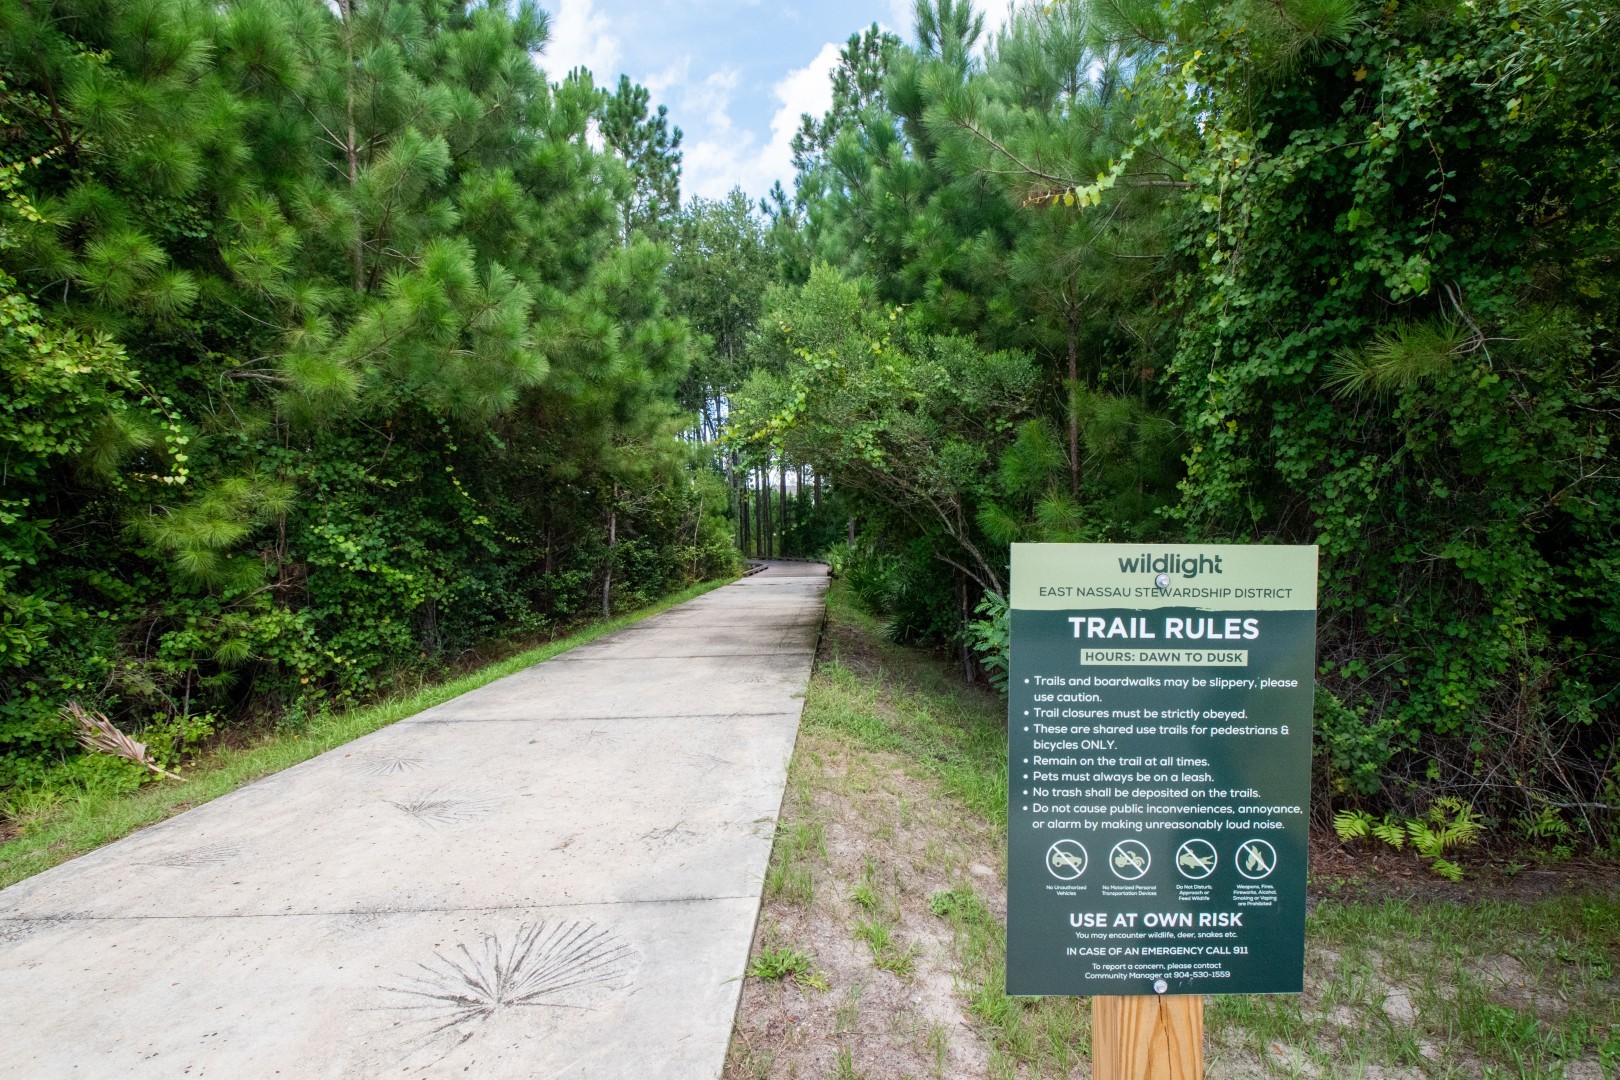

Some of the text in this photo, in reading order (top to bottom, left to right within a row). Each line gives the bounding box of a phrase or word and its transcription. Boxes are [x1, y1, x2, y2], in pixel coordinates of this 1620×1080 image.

[1118, 554, 1222, 578] wildlight
[1040, 587, 1292, 598] EAST NASSAU STEWARDSHIP DISTRICT
[1068, 617, 1259, 639] TRAIL RULES
[1085, 652, 1243, 663] HOURS: DAWN TO DUSK
[1034, 676, 1298, 689] Trails and boardwalks may be slippery, please
[1057, 693, 1102, 702] caution.
[1034, 708, 1247, 721] Trail closures must be strictly obeyed.
[1034, 724, 1068, 733] These
[1093, 724, 1133, 734] shared
[1159, 725, 1188, 734] trails
[1191, 725, 1208, 734] for
[1211, 726, 1278, 737] pedestrians
[1281, 725, 1289, 735] &
[1034, 740, 1117, 752] bicycles ONLY.
[1034, 756, 1077, 765] Remain
[1097, 756, 1116, 765] the
[1119, 757, 1141, 765] trail
[1145, 757, 1157, 766] at
[1160, 757, 1173, 766] all
[1176, 757, 1209, 766] times.
[1034, 771, 1059, 781] Pets
[1062, 773, 1090, 781] must
[1093, 772, 1133, 784] always
[1137, 772, 1151, 781] be
[1182, 772, 1214, 782] leash.
[1033, 787, 1049, 796] No
[1052, 788, 1082, 797] trash
[1085, 788, 1111, 797] shall
[1115, 788, 1129, 797] be
[1132, 788, 1188, 799] deposited
[1208, 788, 1227, 797] the
[1230, 788, 1261, 797] trails.
[1033, 803, 1048, 812] Do
[1052, 804, 1070, 813] not
[1110, 804, 1143, 815] public
[1147, 804, 1235, 814] inconveniences,
[1238, 806, 1302, 816] annoyance,
[1048, 819, 1081, 828] alarm
[1085, 819, 1098, 831] by
[1102, 820, 1142, 832] making
[1145, 820, 1223, 831] unreasonably
[1226, 820, 1250, 829] loud
[1253, 820, 1284, 829] noise.
[1070, 913, 1242, 927] USE AT OWN RISK
[1142, 947, 1203, 955] EMERGENCY
[1085, 972, 1127, 980] Community
[1129, 972, 1163, 980] Manager
[1174, 971, 1230, 979] 904-530-1559
